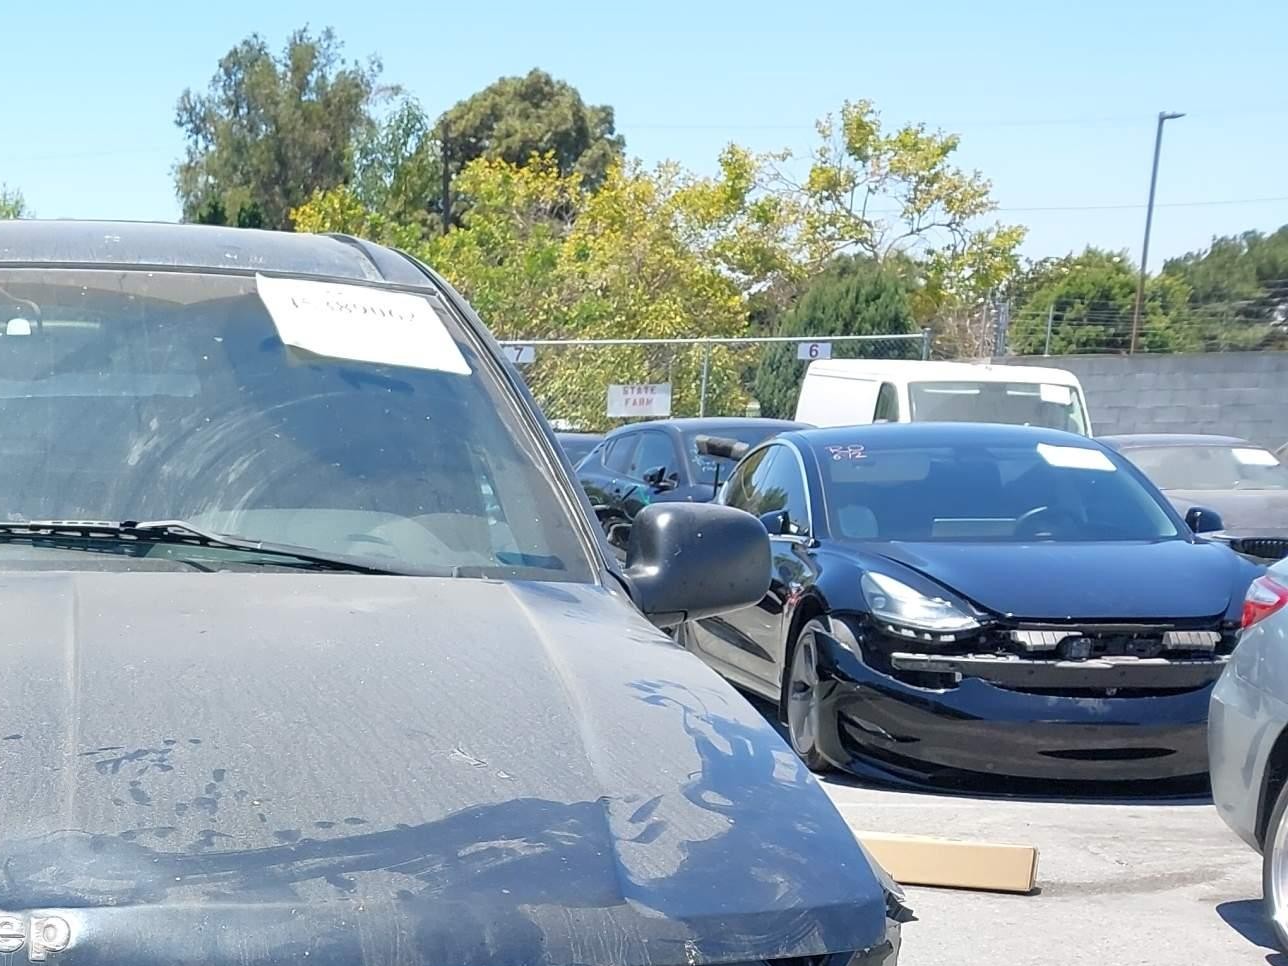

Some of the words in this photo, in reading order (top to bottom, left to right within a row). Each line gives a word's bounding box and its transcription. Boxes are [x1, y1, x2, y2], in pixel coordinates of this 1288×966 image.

[514, 347, 524, 361] 7
[809, 343, 819, 358] 6
[623, 385, 656, 395] STATE
[624, 397, 653, 408] FARM
